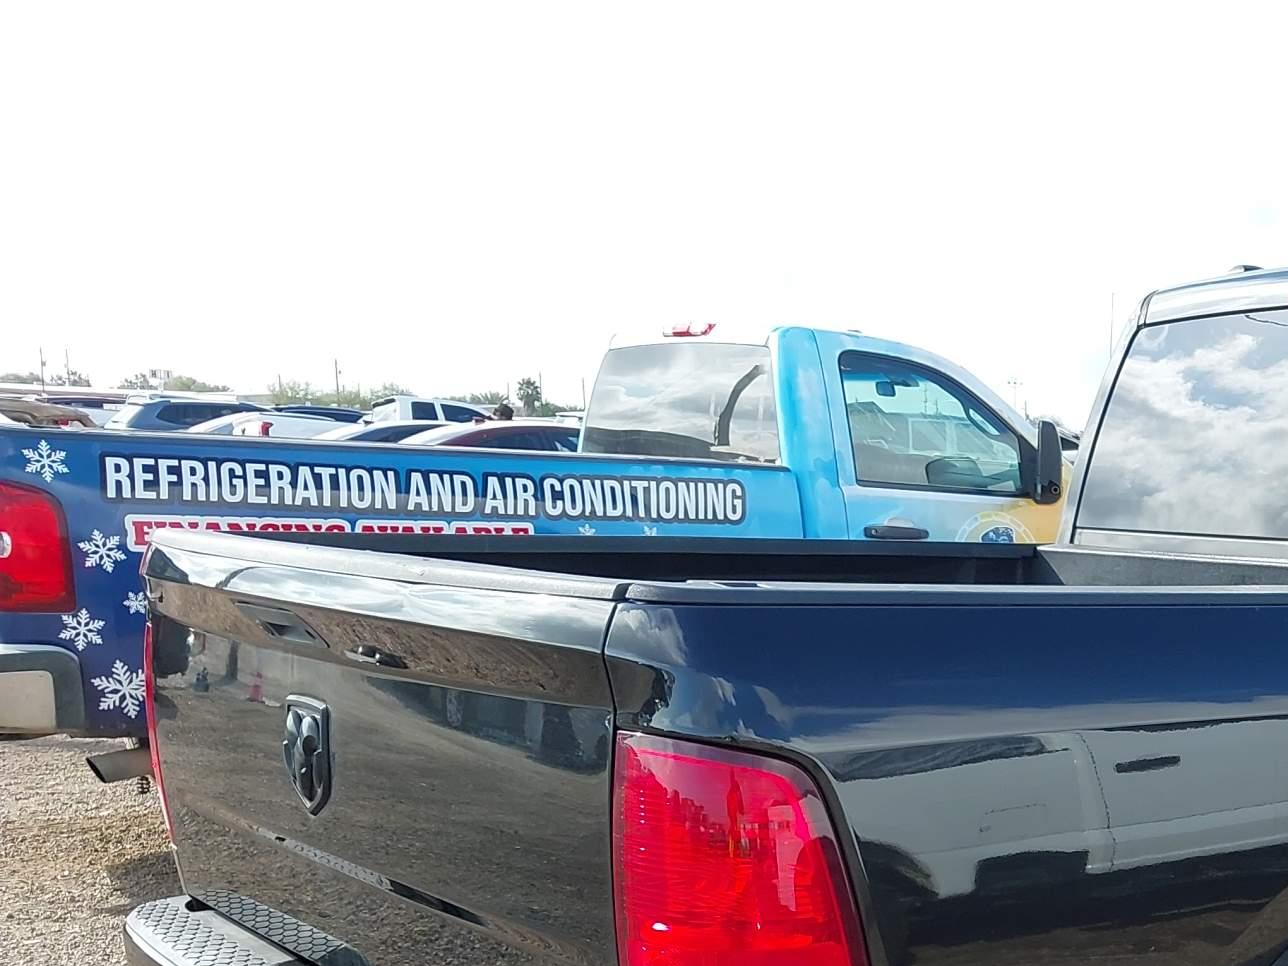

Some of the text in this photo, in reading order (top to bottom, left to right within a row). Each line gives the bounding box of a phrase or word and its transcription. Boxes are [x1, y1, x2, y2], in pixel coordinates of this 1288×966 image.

[105, 457, 743, 521] REFRIGERATION AND AIR CONDITIONING
